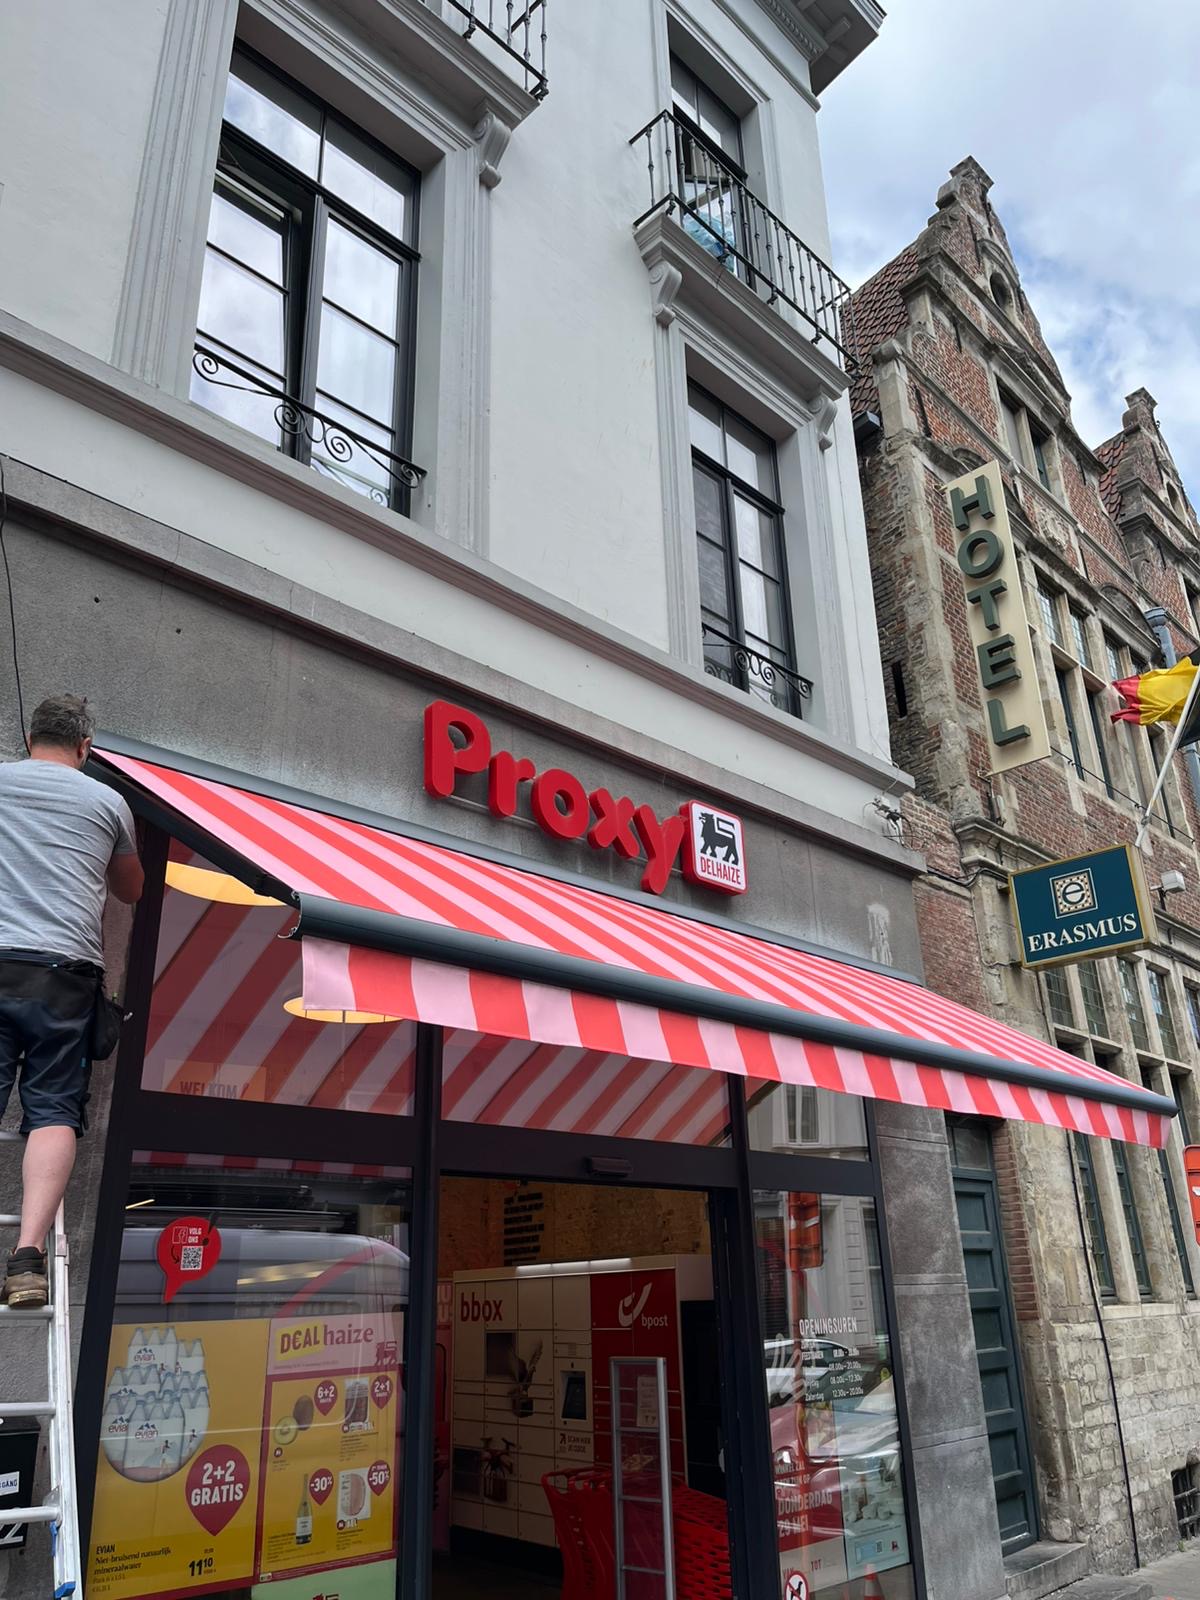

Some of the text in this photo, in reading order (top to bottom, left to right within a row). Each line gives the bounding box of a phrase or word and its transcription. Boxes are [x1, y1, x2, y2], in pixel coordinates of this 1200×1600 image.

[950, 474, 1031, 749] HOTEL
[423, 700, 688, 894] Proxy
[700, 856, 742, 885] DELHAIZE
[1028, 913, 1137, 953] ERASMUS
[189, 1227, 202, 1236] VOLG
[188, 1236, 199, 1244] ONS
[461, 1291, 504, 1322] bbox
[641, 1313, 668, 1329] bpost
[799, 1317, 858, 1336] OPENINGSUREN
[324, 1323, 374, 1347] haize
[134, 1351, 157, 1362] evian
[318, 1385, 335, 1398] 6+2
[374, 1380, 390, 1393] 2+1
[108, 1422, 129, 1434] evia
[134, 1426, 159, 1438] evian
[202, 1460, 236, 1486] 2+2
[369, 1471, 390, 1486] -50%
[310, 1476, 333, 1493] -30%
[191, 1484, 244, 1507] GRATIS
[778, 1491, 833, 1516] DONDERDAG
[96, 1544, 116, 1555] EVIAN
[141, 1546, 172, 1558] natuurlijk
[94, 1561, 142, 1576] mineraalwater
[811, 1558, 822, 1572] TOT
